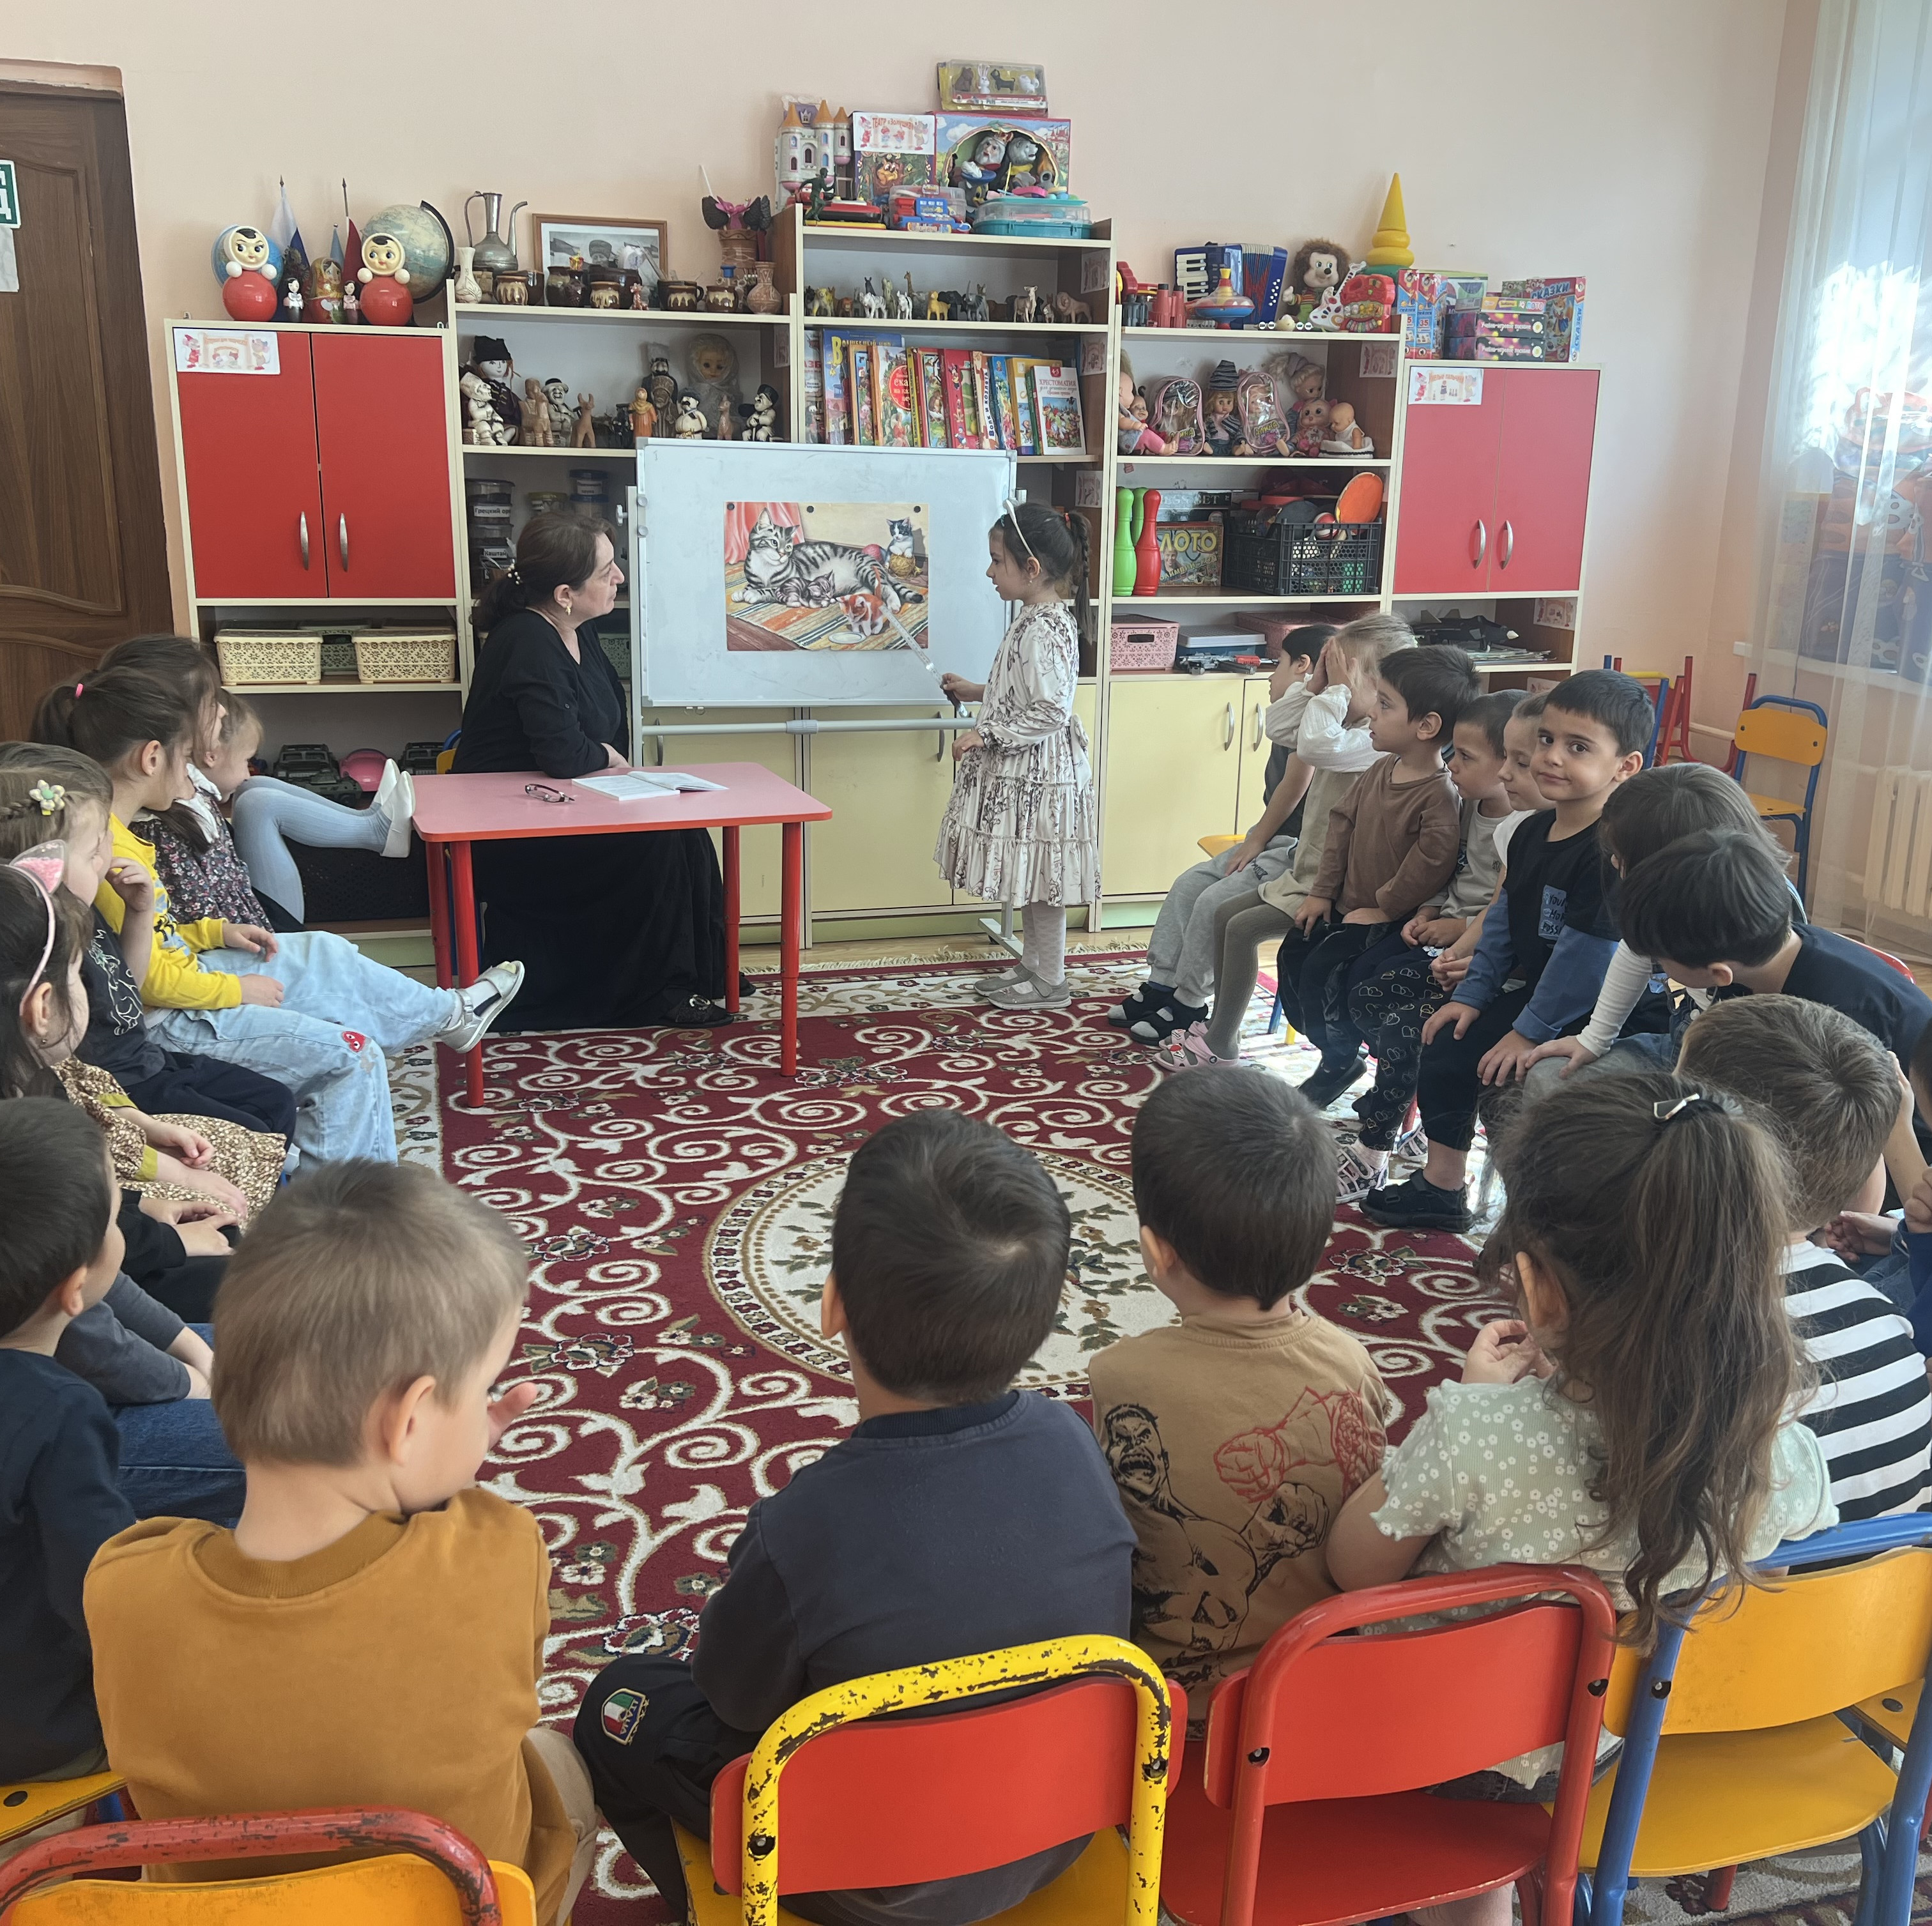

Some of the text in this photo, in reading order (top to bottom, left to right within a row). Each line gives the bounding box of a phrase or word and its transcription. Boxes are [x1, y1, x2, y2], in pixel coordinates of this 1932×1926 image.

[894, 378, 909, 387] Ска
[1039, 379, 1077, 387] ХРЕСТОМАТИЯ
[1160, 532, 1217, 552] ЛОТО
